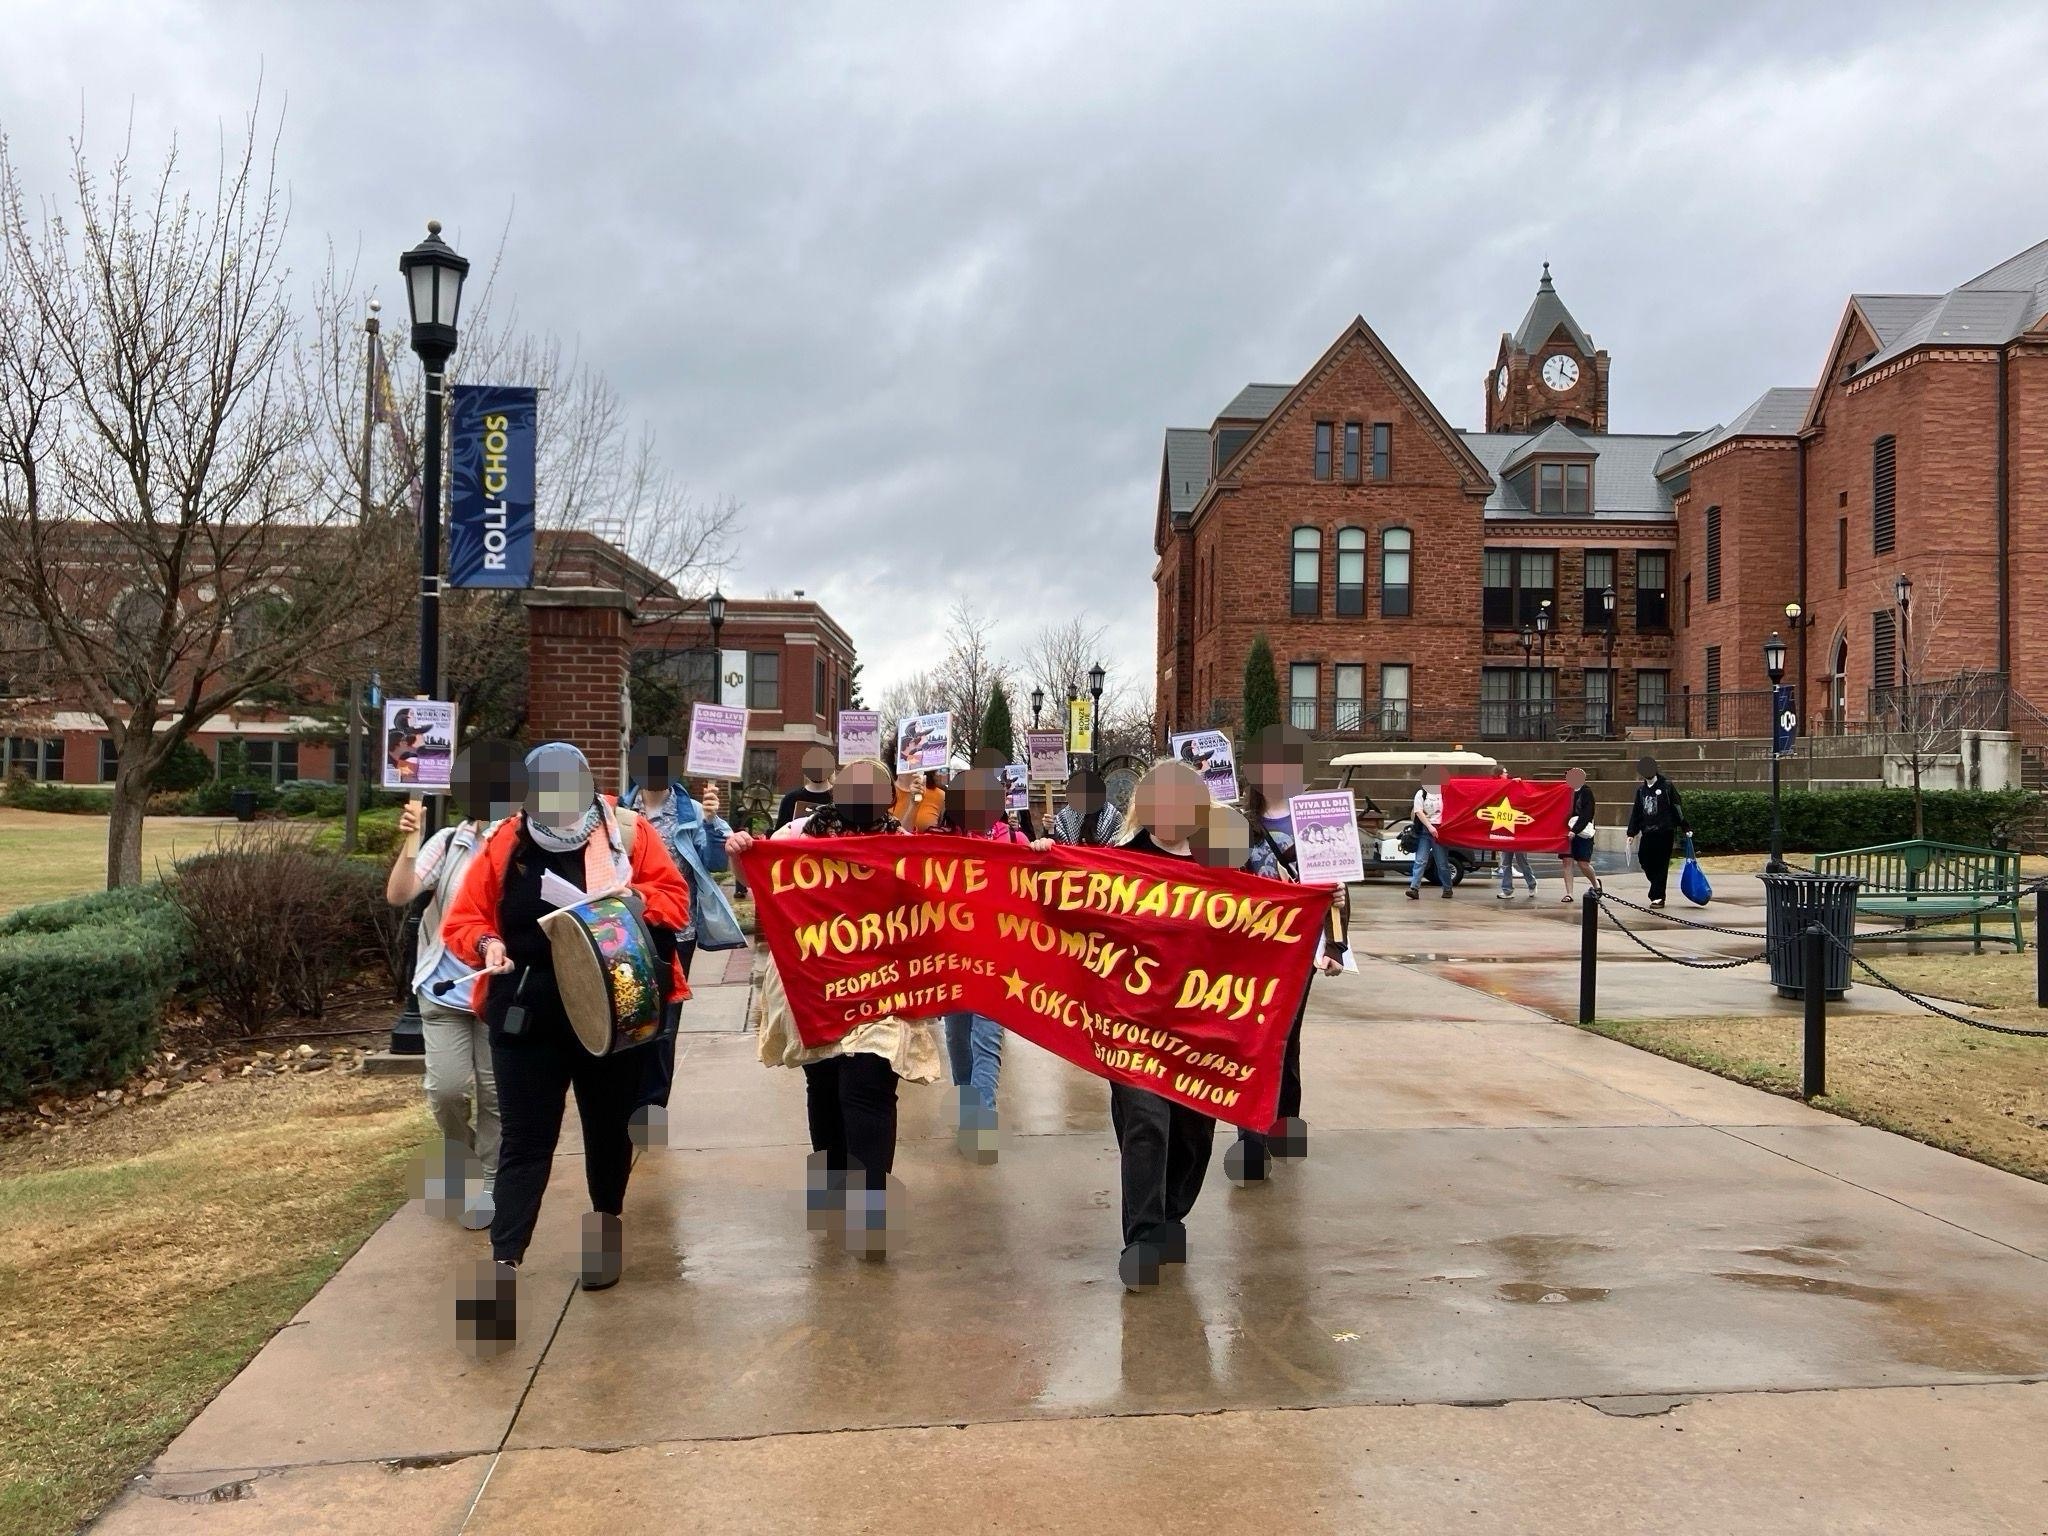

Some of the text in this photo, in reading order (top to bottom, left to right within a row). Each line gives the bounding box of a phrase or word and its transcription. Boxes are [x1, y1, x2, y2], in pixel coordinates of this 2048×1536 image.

[697, 710, 744, 720] LONG LIVE
[1296, 807, 1350, 816] INTERNACIONAL
[1332, 798, 1349, 806] DIA
[1497, 811, 1513, 821] RSU
[1306, 860, 1331, 869] MARZO
[1010, 866, 1302, 943] INTERNATIONAL
[795, 901, 1280, 1024] WORKING WOMEN'S DAY!
[909, 953, 997, 978] DEFENSE
[844, 983, 963, 1022] COMMITTEE
[1030, 982, 1256, 1082] OKC REVOLUTIONARY
[1094, 1042, 1241, 1107] STUDENT UNION
